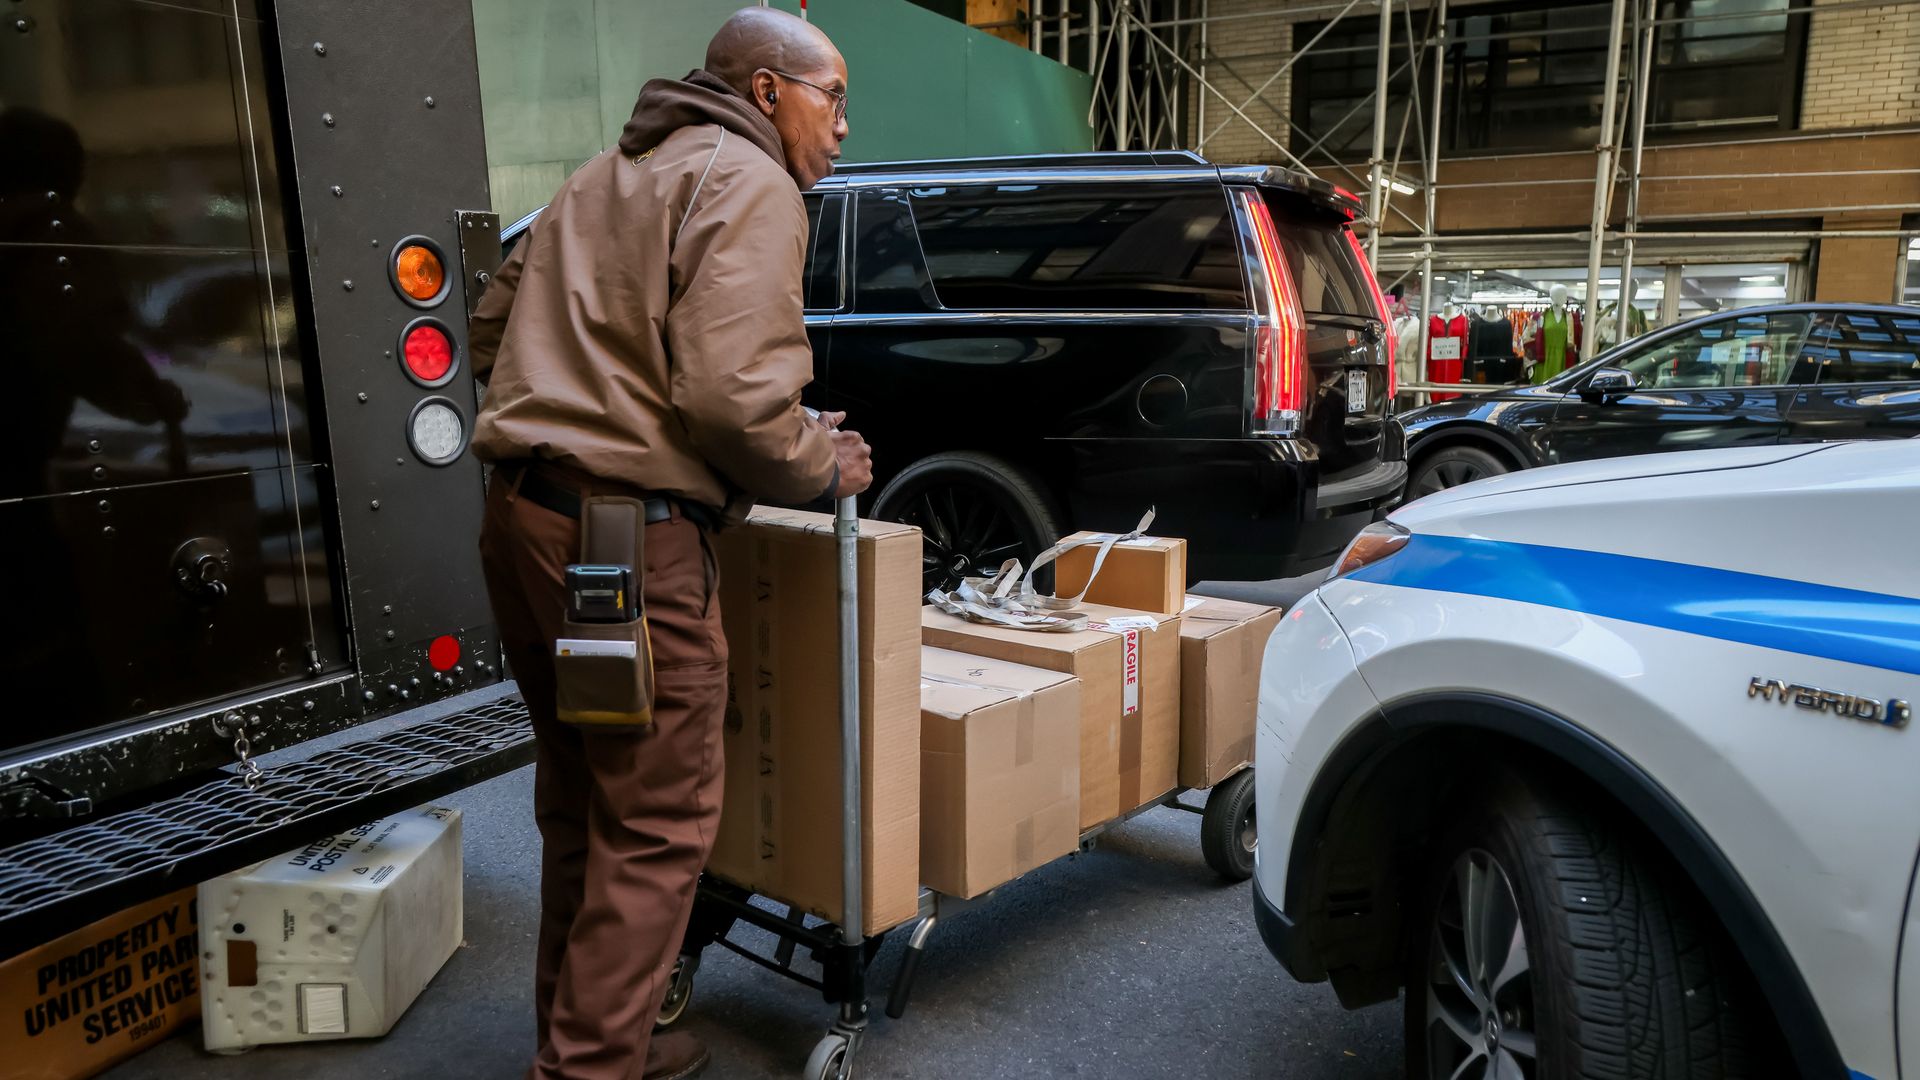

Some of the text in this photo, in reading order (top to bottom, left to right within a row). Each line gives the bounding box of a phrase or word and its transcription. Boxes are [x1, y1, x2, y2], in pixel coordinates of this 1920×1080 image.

[1747, 675, 1884, 721] HYBRID
[308, 838, 361, 872] POSTAL
[37, 904, 180, 996] PROPERTY
[24, 963, 133, 1037] UNITED
[83, 967, 197, 1044] SERVICE
[129, 1013, 168, 1043] 199401
